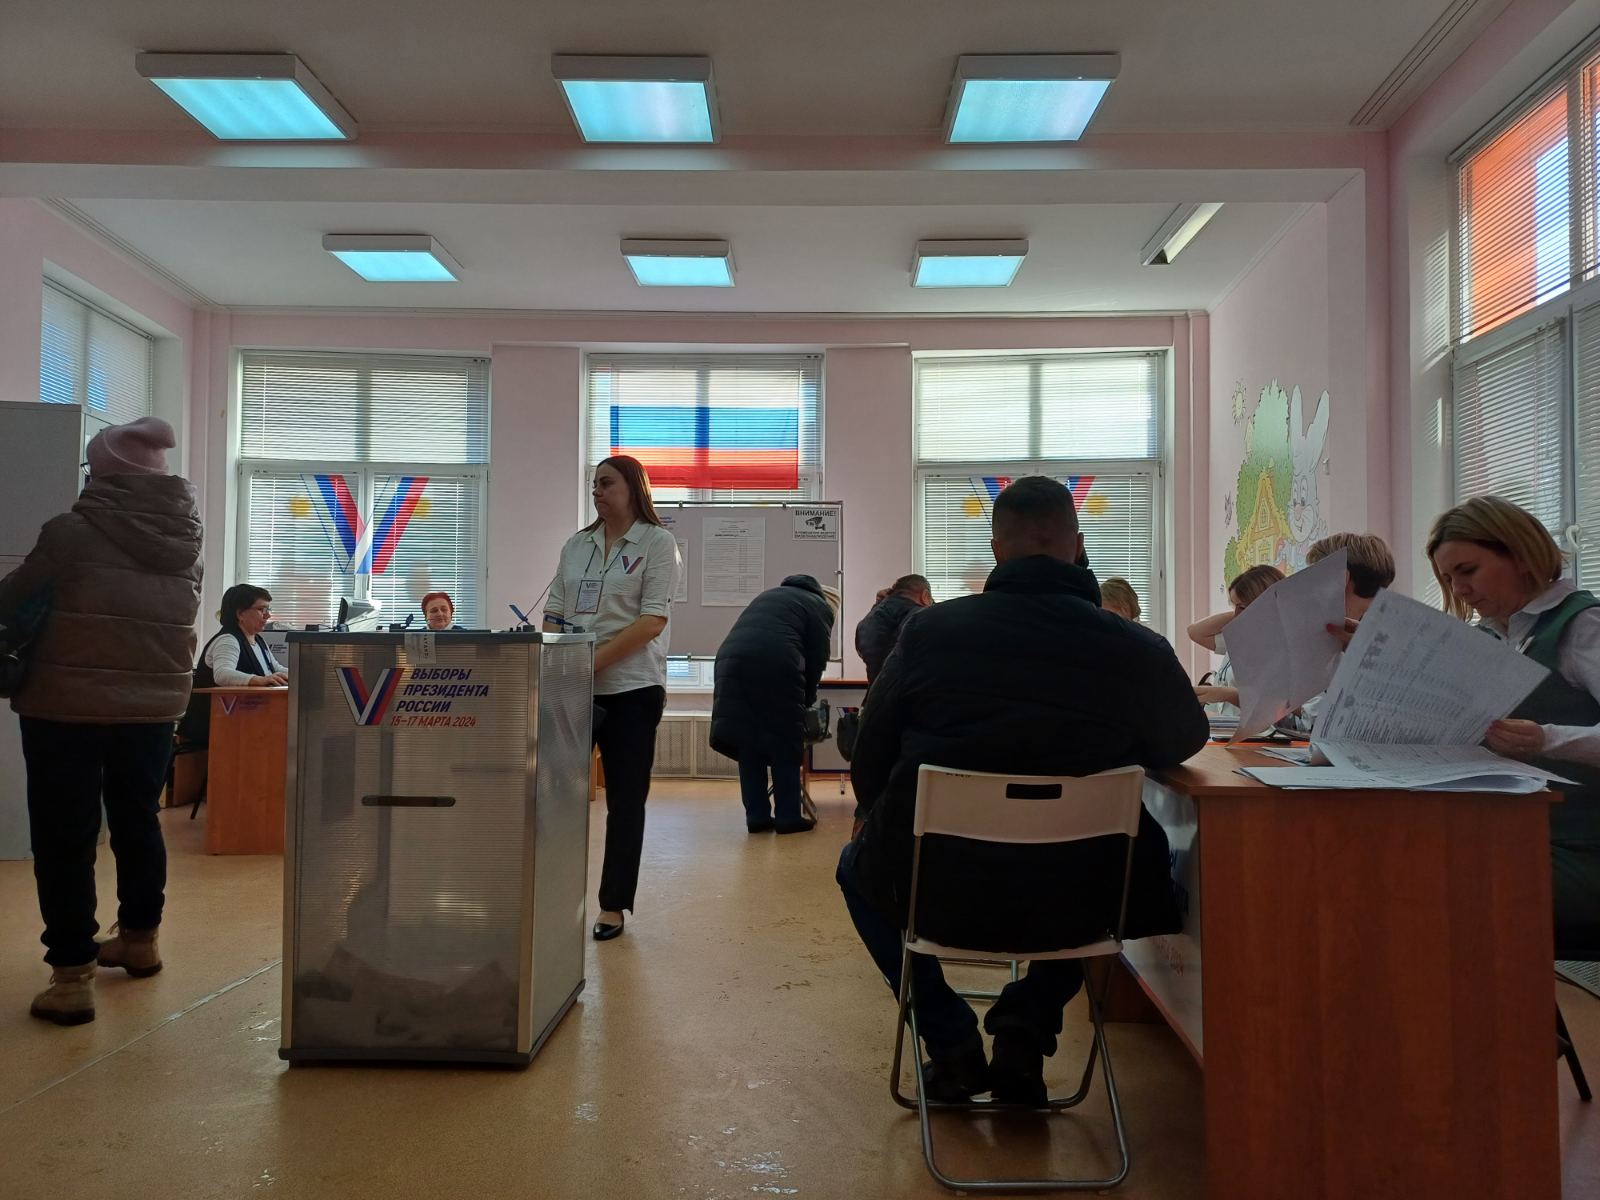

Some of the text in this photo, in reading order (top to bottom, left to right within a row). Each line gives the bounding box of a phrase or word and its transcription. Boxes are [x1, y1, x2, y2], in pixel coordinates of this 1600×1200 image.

[410, 668, 472, 681] ВЫБОРЫ
[403, 685, 489, 698] ПРЕЗИДЕНТА
[396, 700, 452, 713] РОССИИ
[418, 716, 451, 727] МАРТА
[452, 716, 476, 727] 2024
